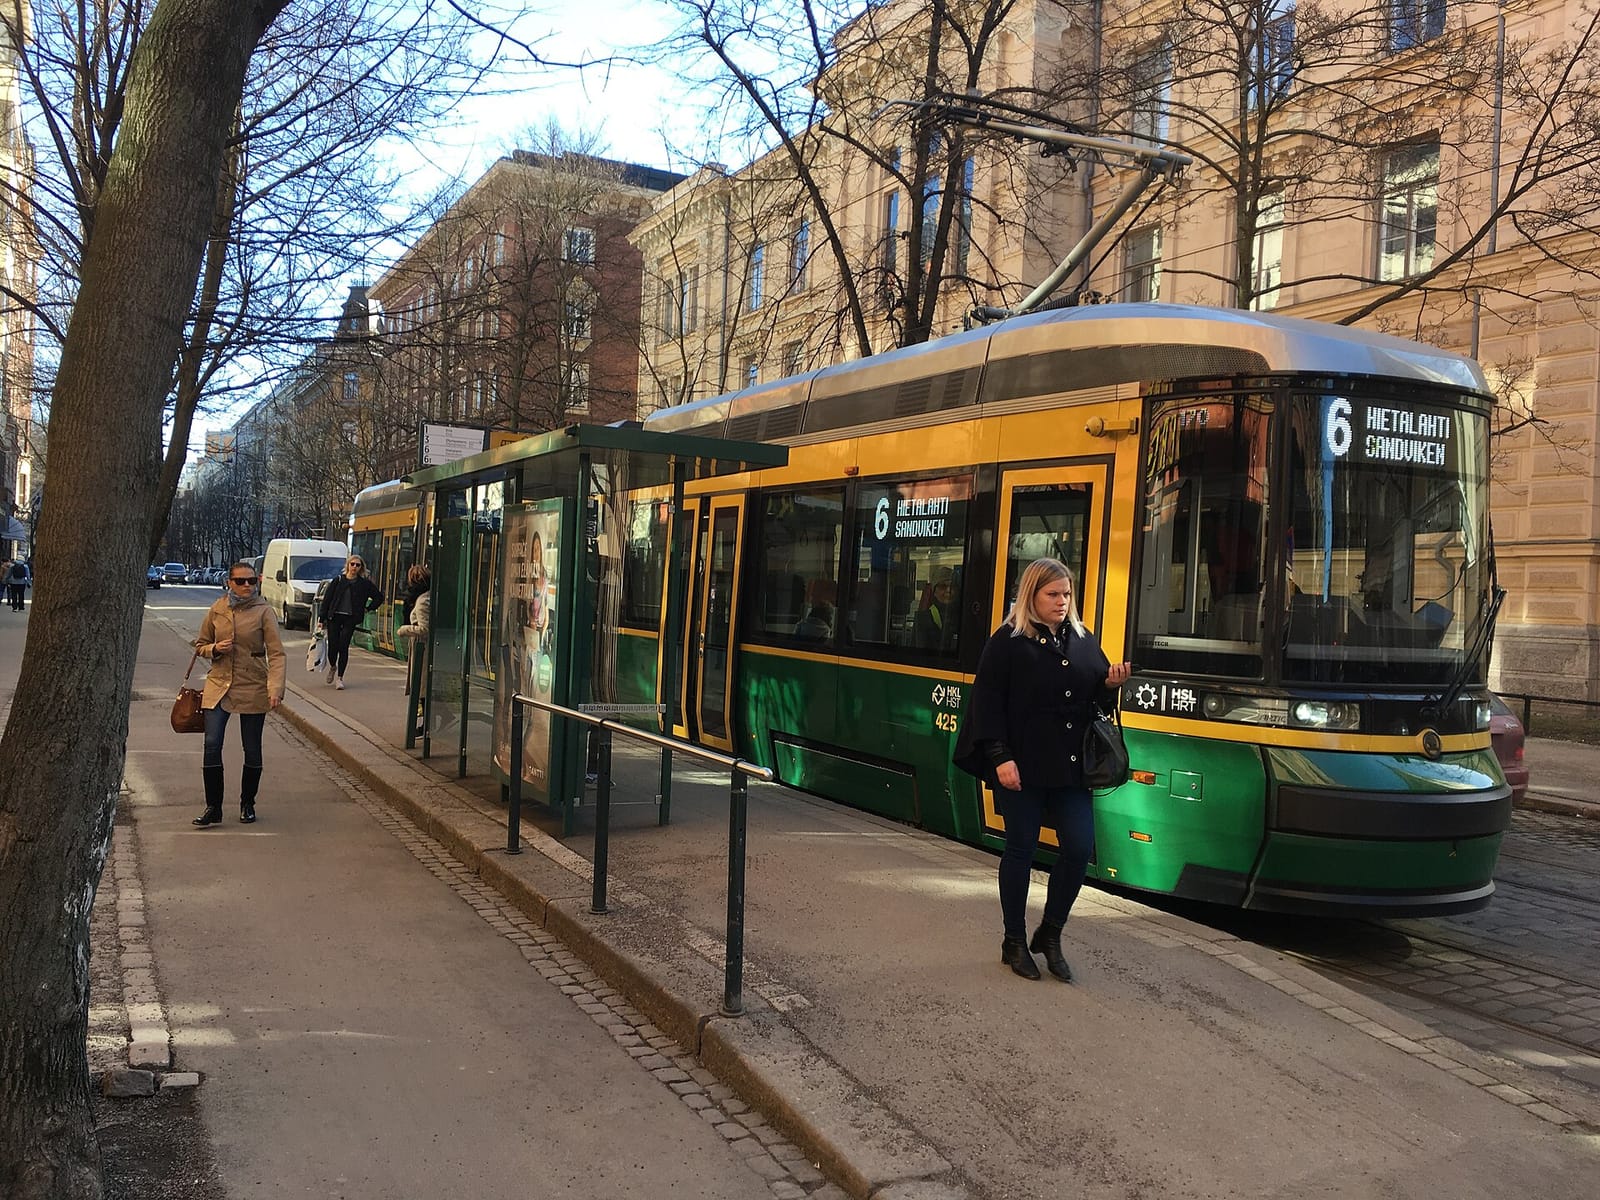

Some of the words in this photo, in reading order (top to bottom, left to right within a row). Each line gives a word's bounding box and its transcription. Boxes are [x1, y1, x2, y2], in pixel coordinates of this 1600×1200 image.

[1327, 397, 1353, 456] 6
[1366, 406, 1451, 439] HIETALAHTI
[424, 435, 430, 444] 3
[424, 445, 430, 454] 6
[1365, 434, 1446, 466] SANDVIKEN
[896, 496, 949, 517] HIETALAHTI
[874, 497, 890, 540] 6
[894, 518, 945, 538] SANDVIKEN
[947, 685, 962, 698] HKL
[1171, 687, 1197, 701] HSL
[946, 696, 961, 709] HST
[1171, 699, 1197, 713] HRT
[935, 712, 958, 733] 425
